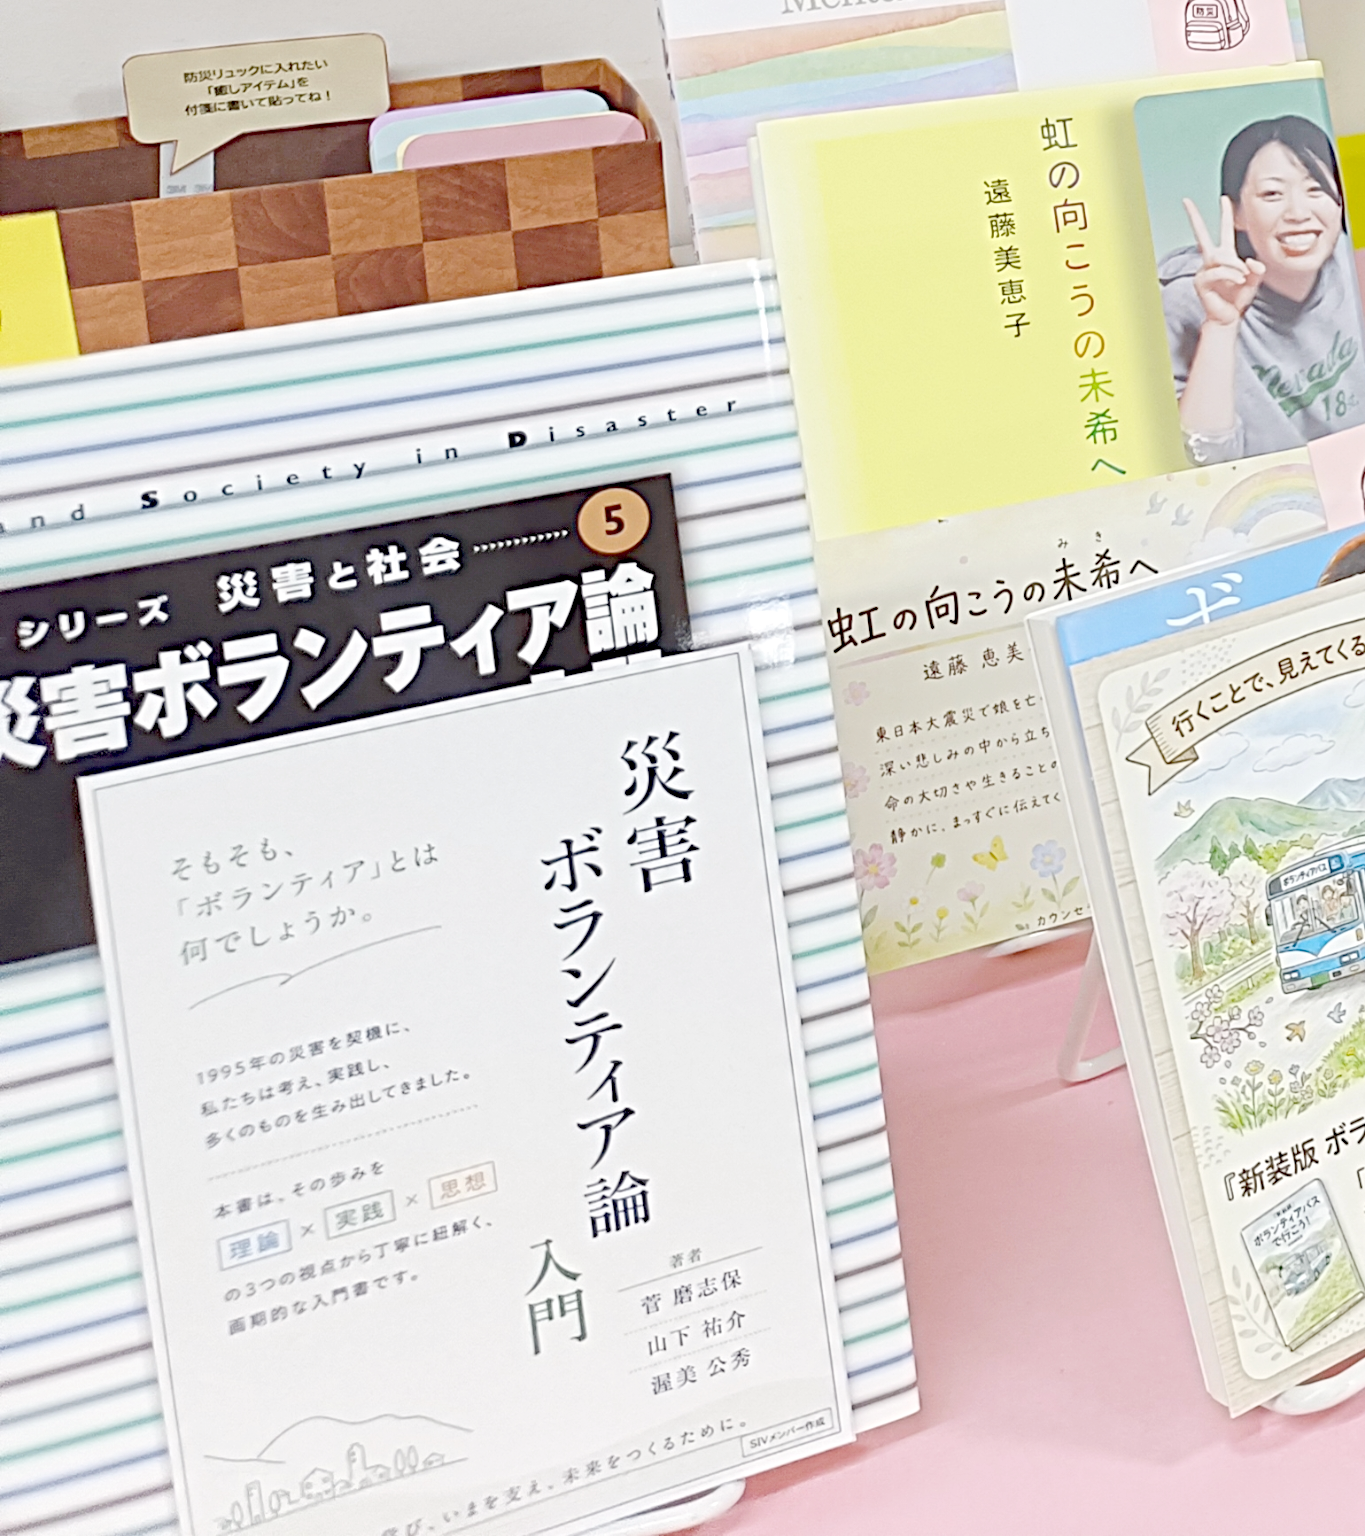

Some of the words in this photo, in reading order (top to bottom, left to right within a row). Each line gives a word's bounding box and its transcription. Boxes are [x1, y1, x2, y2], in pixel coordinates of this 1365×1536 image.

[183, 59, 329, 84] 防災リュックに入れたい
[983, 178, 1031, 339] 遠藤美恵子
[1040, 116, 1127, 476] 虹の向こうの未希へ
[139, 459, 368, 511] Society
[415, 445, 461, 465] in
[507, 396, 742, 450] Disaster
[16, 595, 171, 648] シリーズ
[214, 537, 463, 614] 災害と社会
[603, 504, 626, 536] 5
[827, 548, 1159, 654] 虹の向こうの未希へ
[923, 654, 969, 681] 遠藤
[879, 725, 1051, 779] 深い悲しみの中から立ち
[619, 729, 701, 894] 災害
[890, 791, 1062, 845] 静かに、まっすぐに伝えてく
[171, 838, 294, 882] そもそも、
[176, 842, 438, 918] 「ボランティア」とは
[180, 905, 373, 966] 何でしょうか。
[196, 1021, 411, 1086] 1995年の災害を契機に、
[539, 826, 653, 1239] ボランティア論
[200, 1058, 391, 1118] 私たちは考え、実践し、
[205, 1068, 472, 1151] 多くのものを生み出してきました。
[213, 1161, 385, 1220] 本書は、その歩みを
[1223, 1137, 1319, 1202] 『新装版
[228, 1229, 281, 1262] 理論
[333, 1200, 385, 1231] 実践
[438, 1170, 488, 1201] 思想
[668, 1245, 704, 1270] 著者
[228, 1269, 419, 1336] 画期的な入門書です。
[523, 1237, 589, 1357] 入門
[641, 1292, 661, 1317] 菅
[672, 1266, 743, 1308] 磨志保
[646, 1326, 694, 1356] 山下
[703, 1308, 749, 1343] 祐介
[650, 1364, 698, 1397] 渥美
[708, 1347, 753, 1377] 公秀
[749, 1415, 826, 1450] SIVメンバー作成
